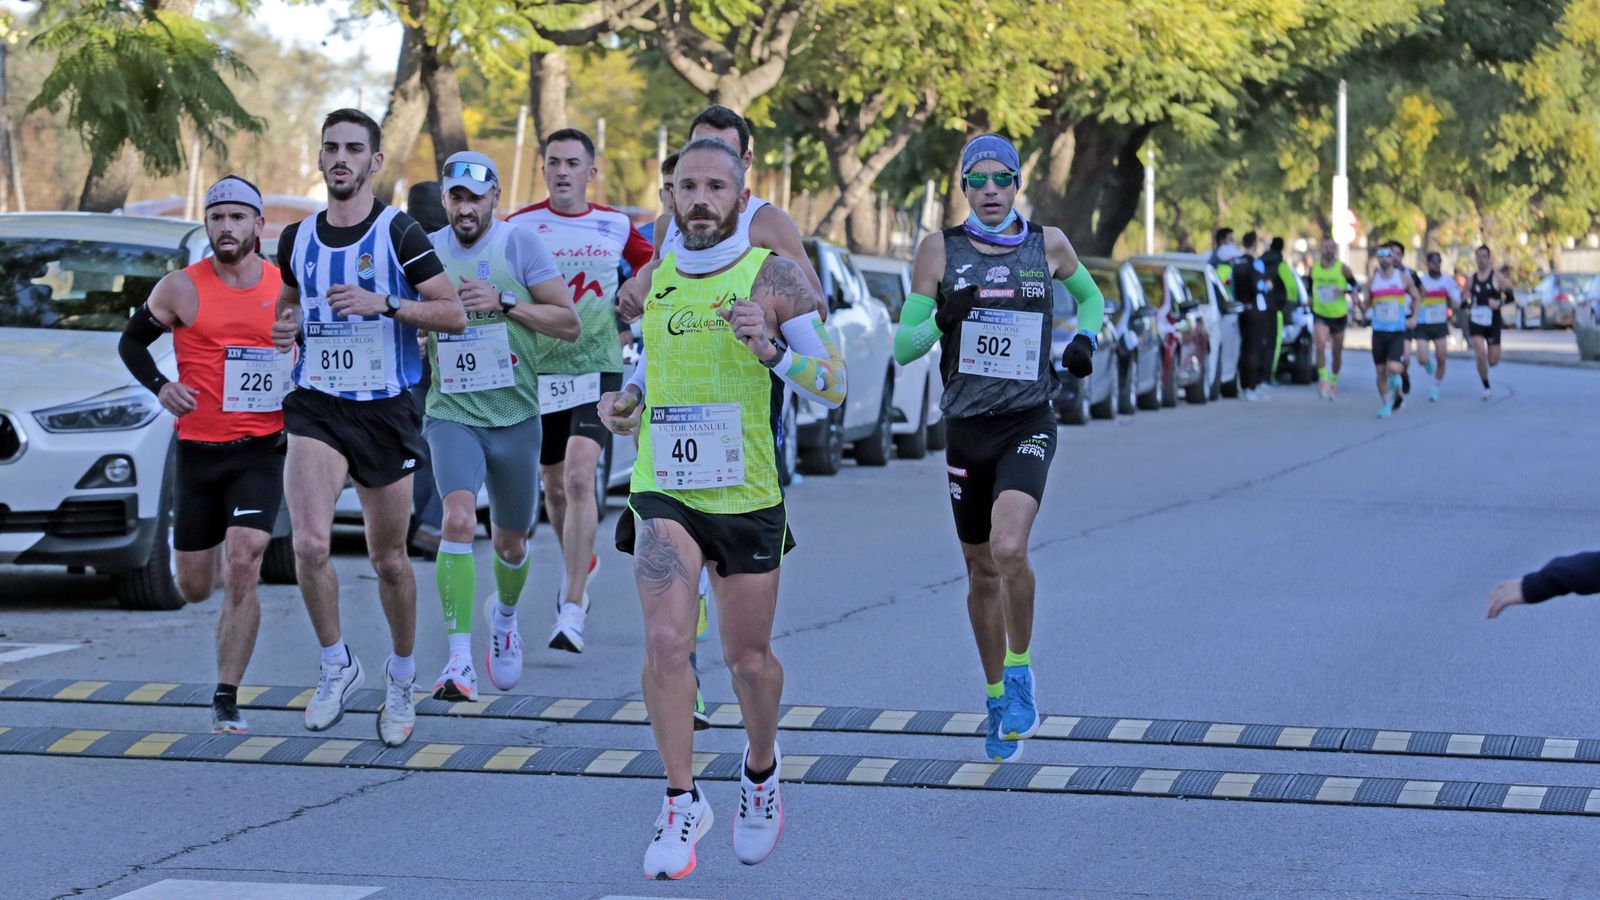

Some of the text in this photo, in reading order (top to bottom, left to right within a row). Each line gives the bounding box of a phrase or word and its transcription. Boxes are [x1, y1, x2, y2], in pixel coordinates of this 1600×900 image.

[1020, 269, 1044, 278] bathco
[1020, 287, 1045, 298] TEAM
[309, 325, 321, 335] XXV
[343, 336, 375, 344] CARLOS
[976, 335, 1012, 357] 502
[227, 349, 242, 359] XXV
[321, 349, 354, 370] 810
[456, 353, 477, 372] 49
[240, 372, 273, 392] 226
[550, 380, 575, 397] 531
[652, 408, 665, 420] XXV
[689, 423, 728, 431] MANUEL
[671, 438, 698, 463] 40
[1016, 446, 1045, 461] TEAM
